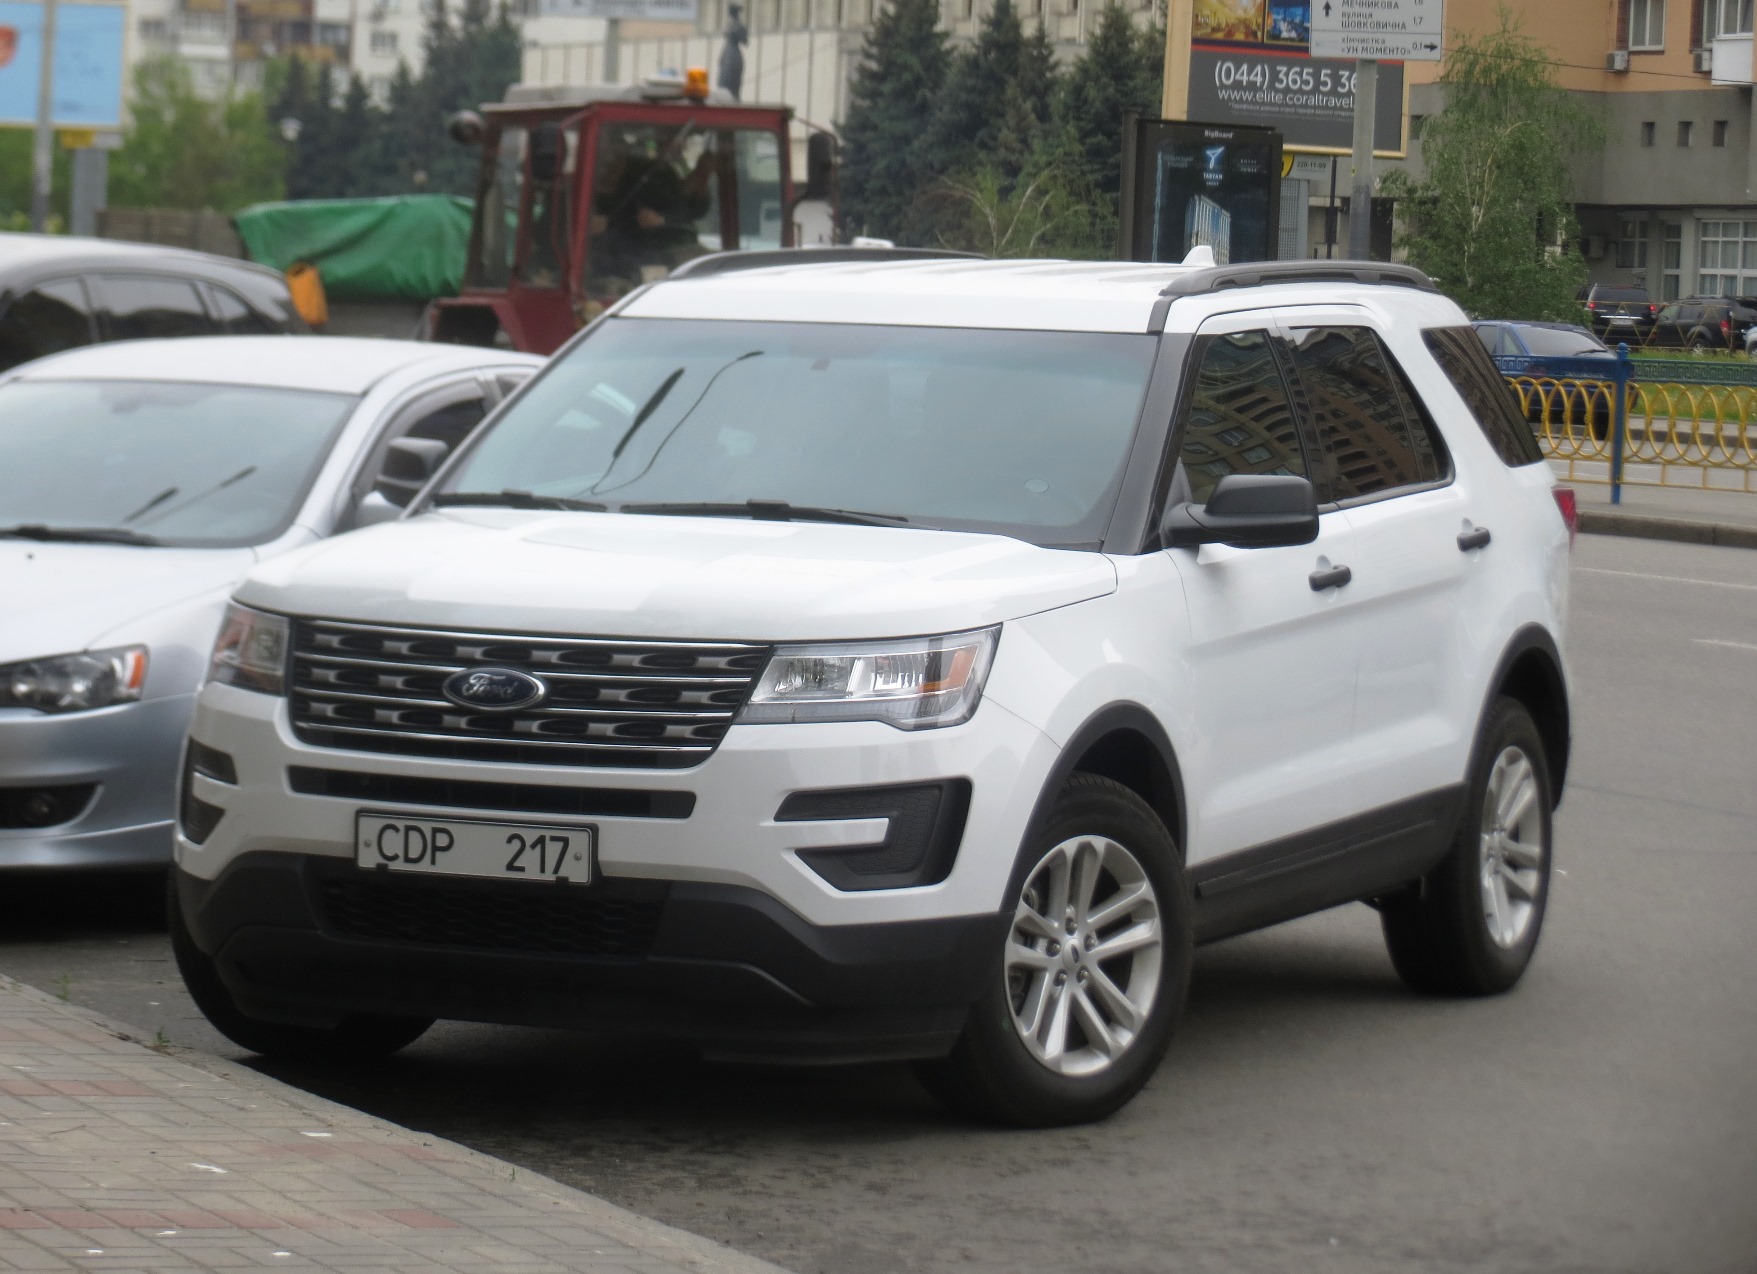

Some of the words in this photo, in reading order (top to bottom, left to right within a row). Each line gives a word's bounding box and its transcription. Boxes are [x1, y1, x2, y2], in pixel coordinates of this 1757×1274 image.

[1341, 0, 1399, 10] МЕЧНИКОВА
[1341, 12, 1373, 20] вулиця
[1413, 16, 1424, 26] 1,7
[1341, 20, 1407, 30] ШОВКОВИЧНА
[1214, 60, 1269, 90] (044)
[1274, 65, 1314, 91] 365
[1319, 68, 1332, 92] 5
[1204, 129, 1233, 139] BigBoard
[462, 673, 519, 697] Ford
[376, 823, 455, 866] CDP
[505, 833, 570, 875] 217
